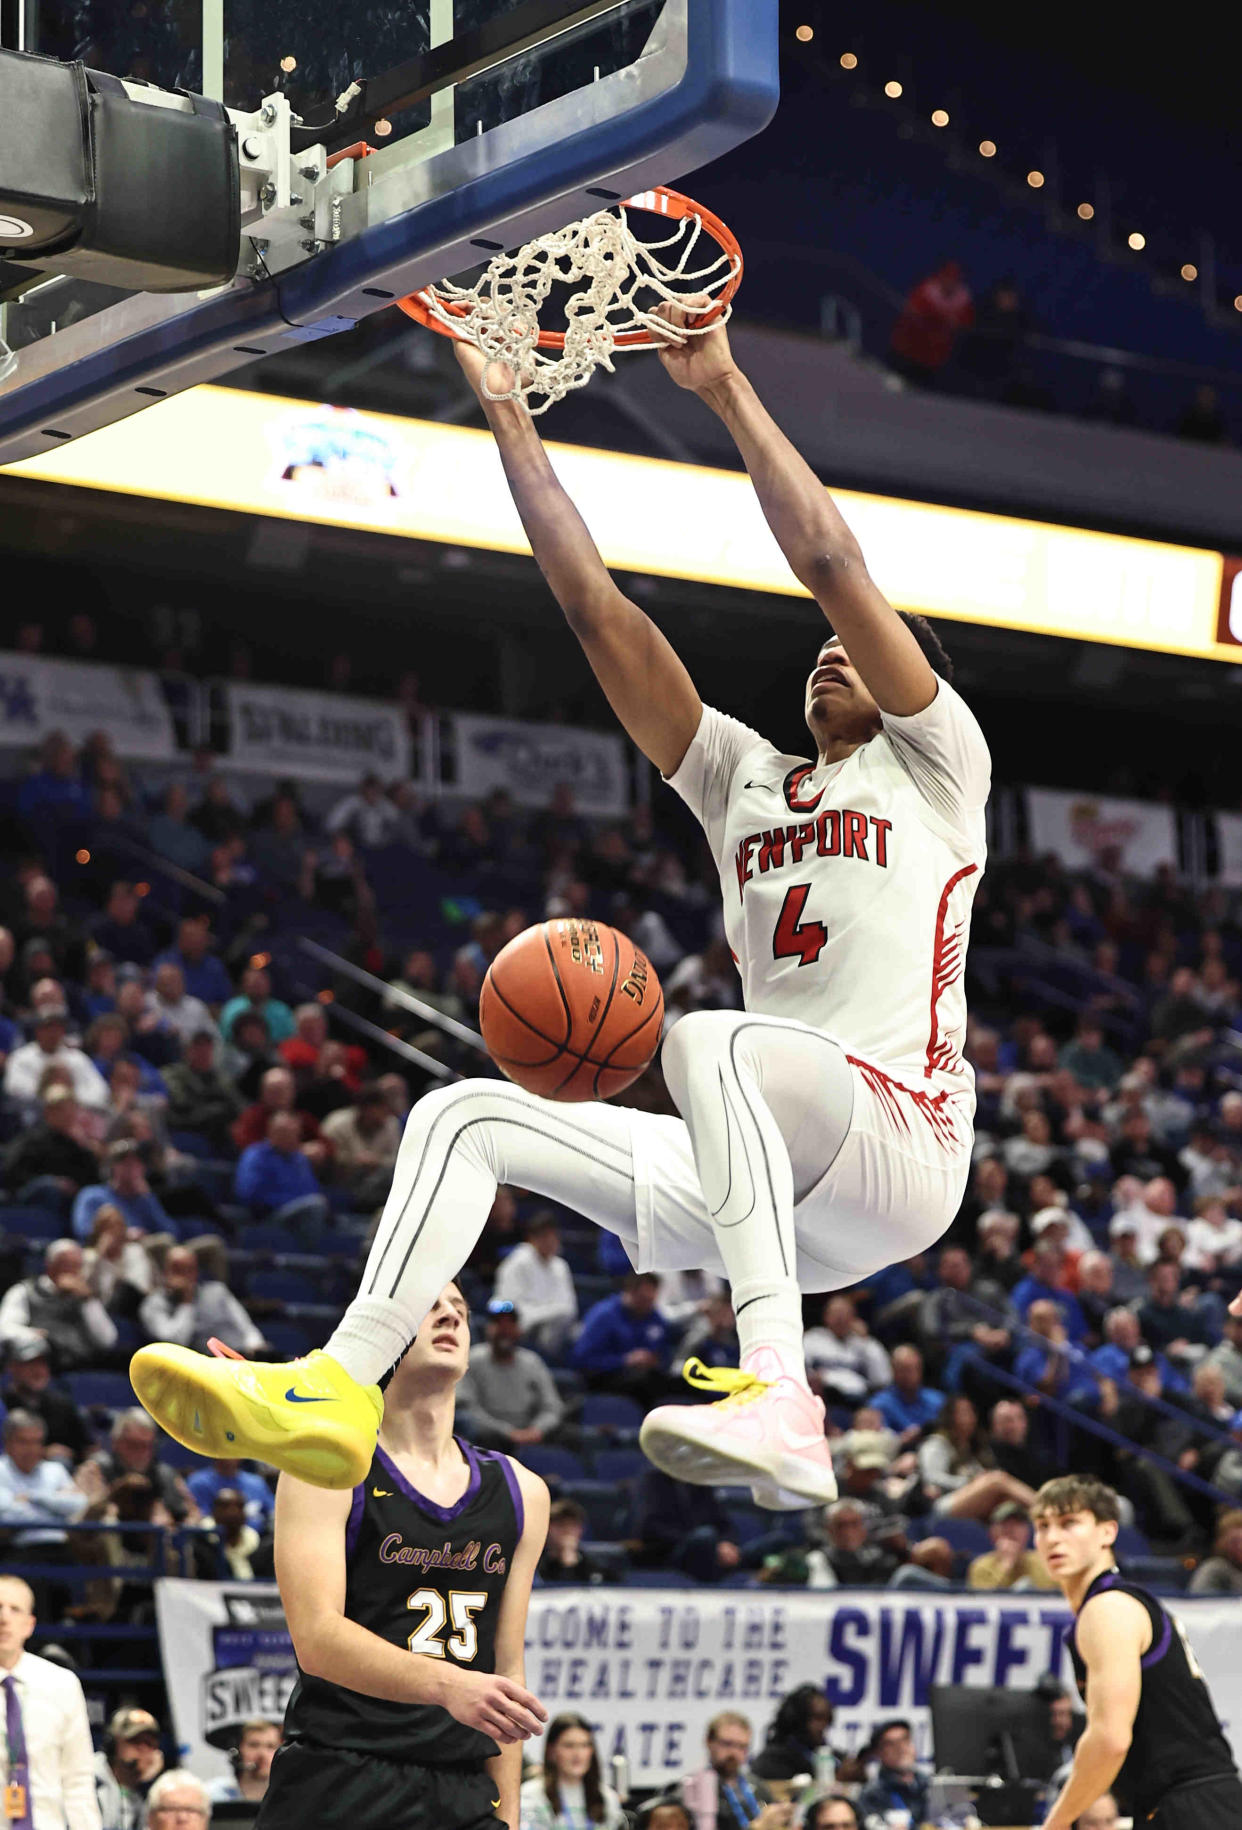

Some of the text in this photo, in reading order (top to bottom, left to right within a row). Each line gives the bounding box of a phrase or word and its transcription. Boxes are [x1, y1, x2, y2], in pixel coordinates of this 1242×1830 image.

[735, 809, 893, 907] NEWPORT
[773, 883, 828, 967] 4
[379, 1533, 480, 1573] Campbell
[407, 1587, 488, 1662] 25
[524, 1605, 788, 1650] COME TO THE
[538, 1658, 789, 1698] HEALTHCARE
